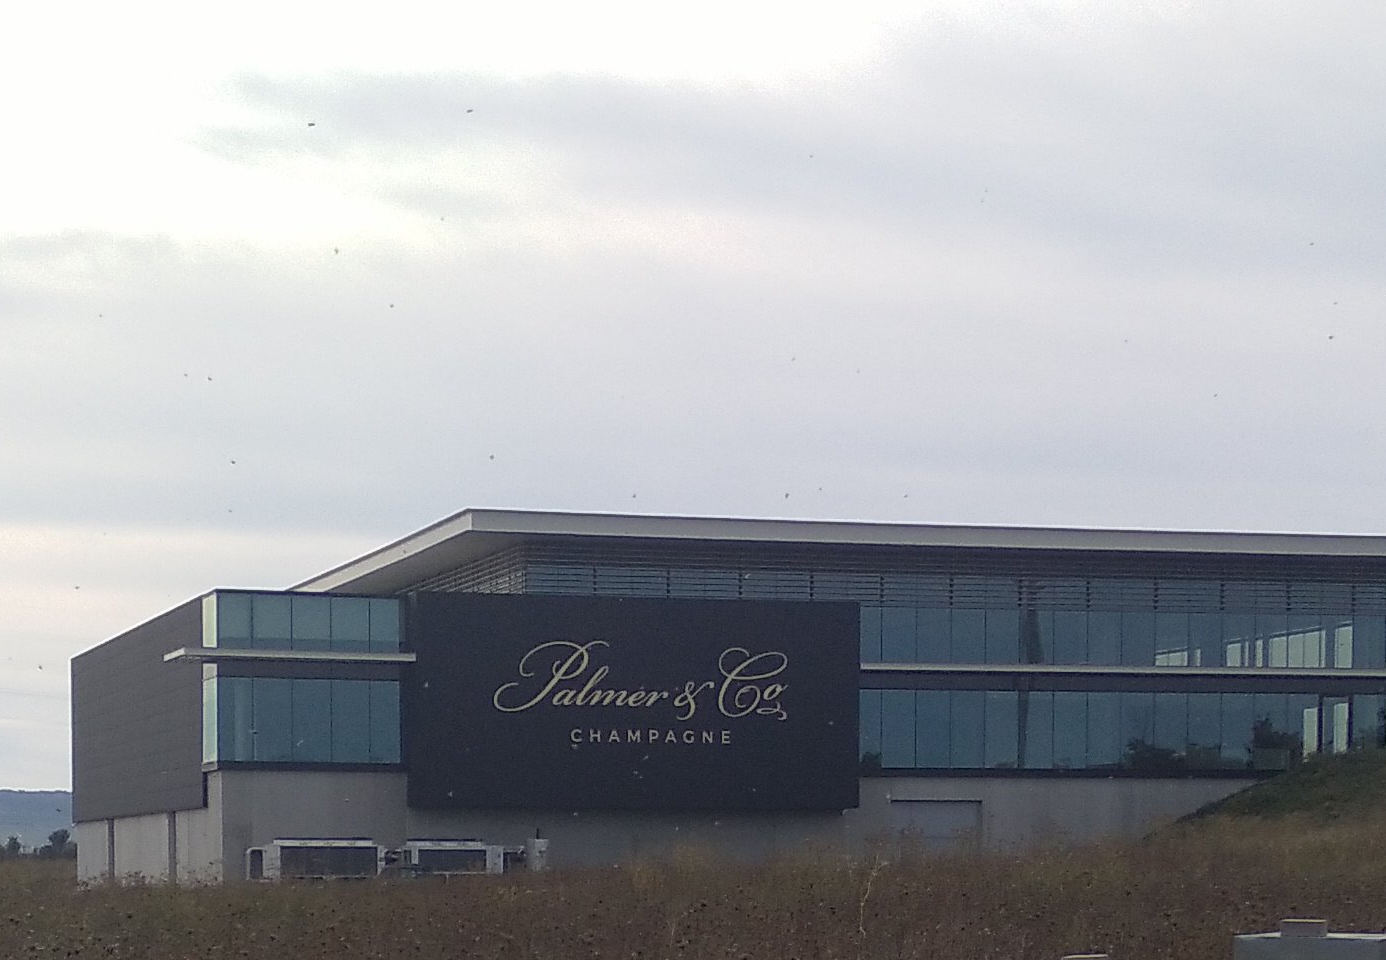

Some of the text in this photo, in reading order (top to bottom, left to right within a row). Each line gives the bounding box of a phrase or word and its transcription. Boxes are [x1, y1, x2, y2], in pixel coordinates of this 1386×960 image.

[493, 640, 669, 713] Palmer
[673, 681, 715, 721] &
[570, 728, 732, 745] CHAMPAGNE
